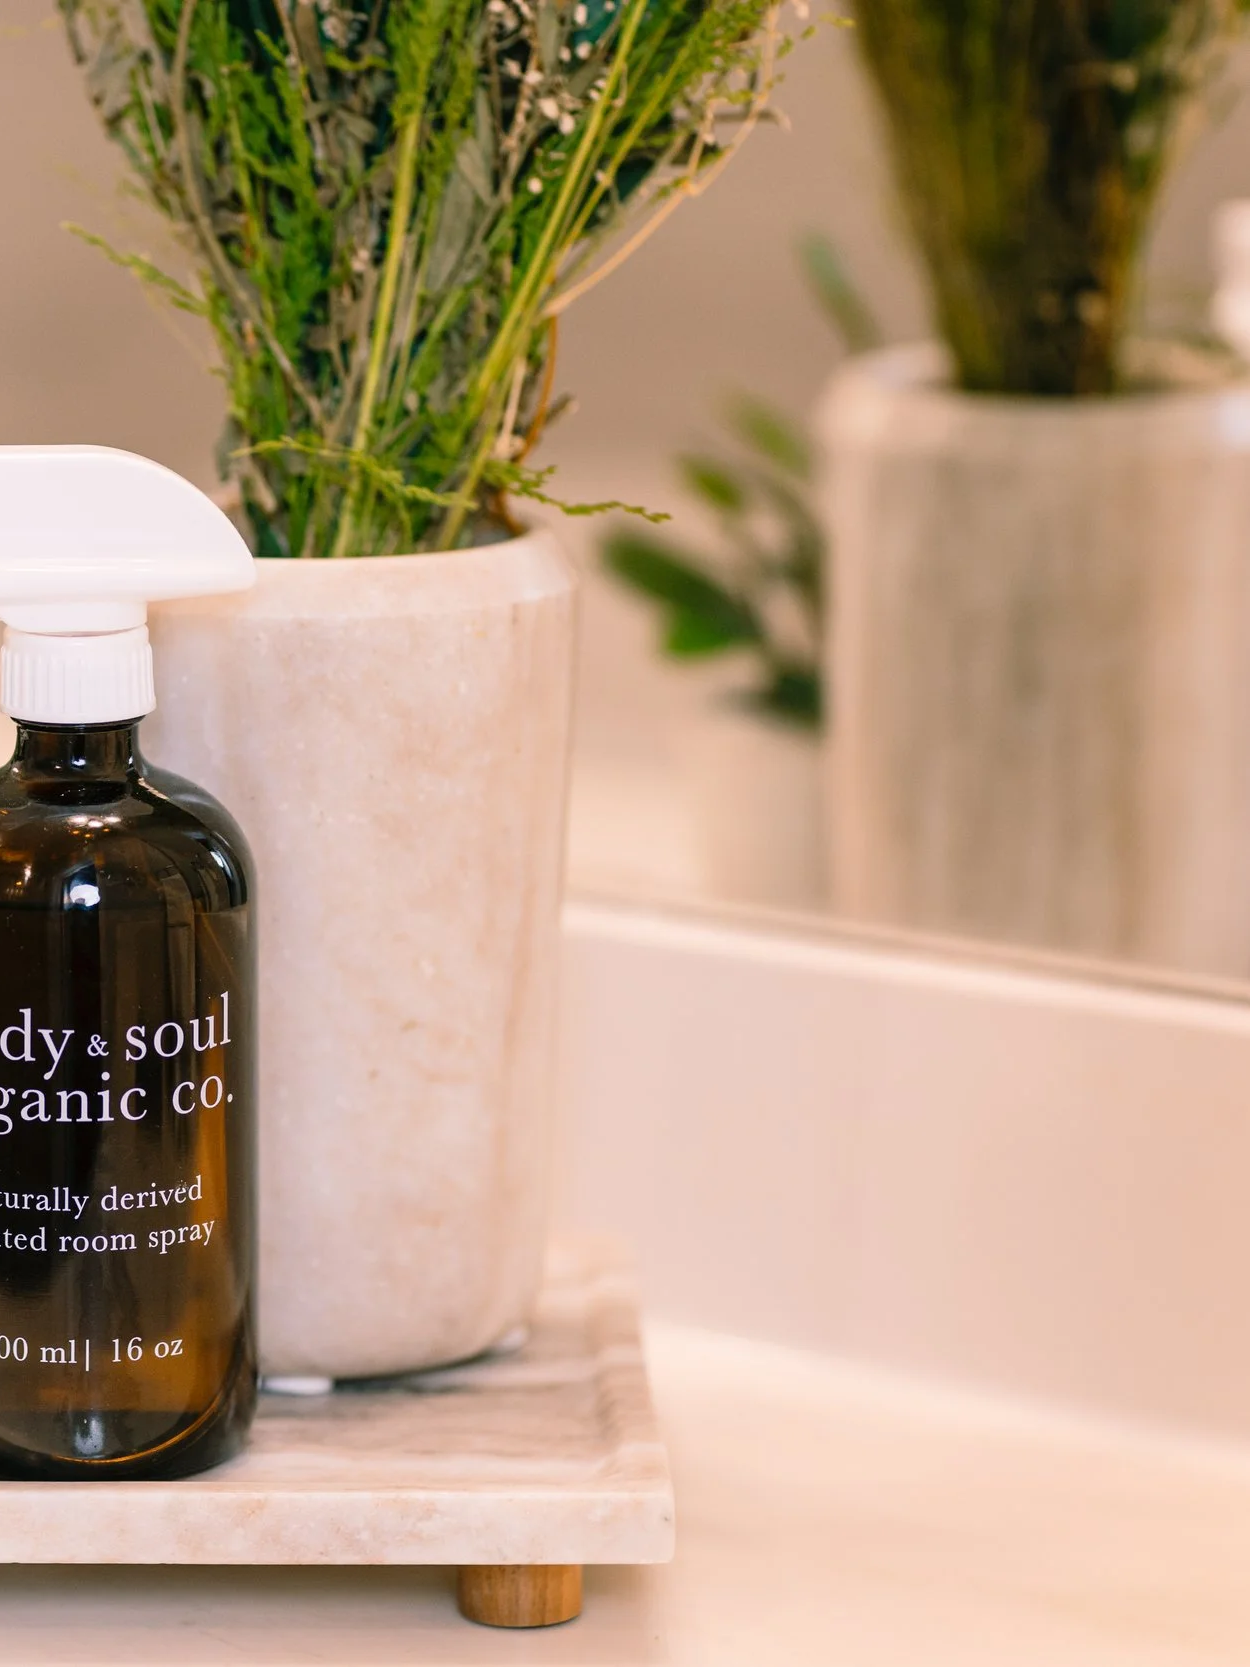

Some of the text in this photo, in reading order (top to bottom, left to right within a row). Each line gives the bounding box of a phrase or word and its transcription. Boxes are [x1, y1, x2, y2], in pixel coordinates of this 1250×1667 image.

[86, 1033, 109, 1057] &
[125, 991, 231, 1061] soul
[171, 1075, 233, 1114] co.
[100, 1174, 202, 1212] derived
[58, 1231, 137, 1252] room
[148, 1219, 215, 1255] spray
[112, 1336, 143, 1363] 16
[154, 1336, 184, 1359] oz
